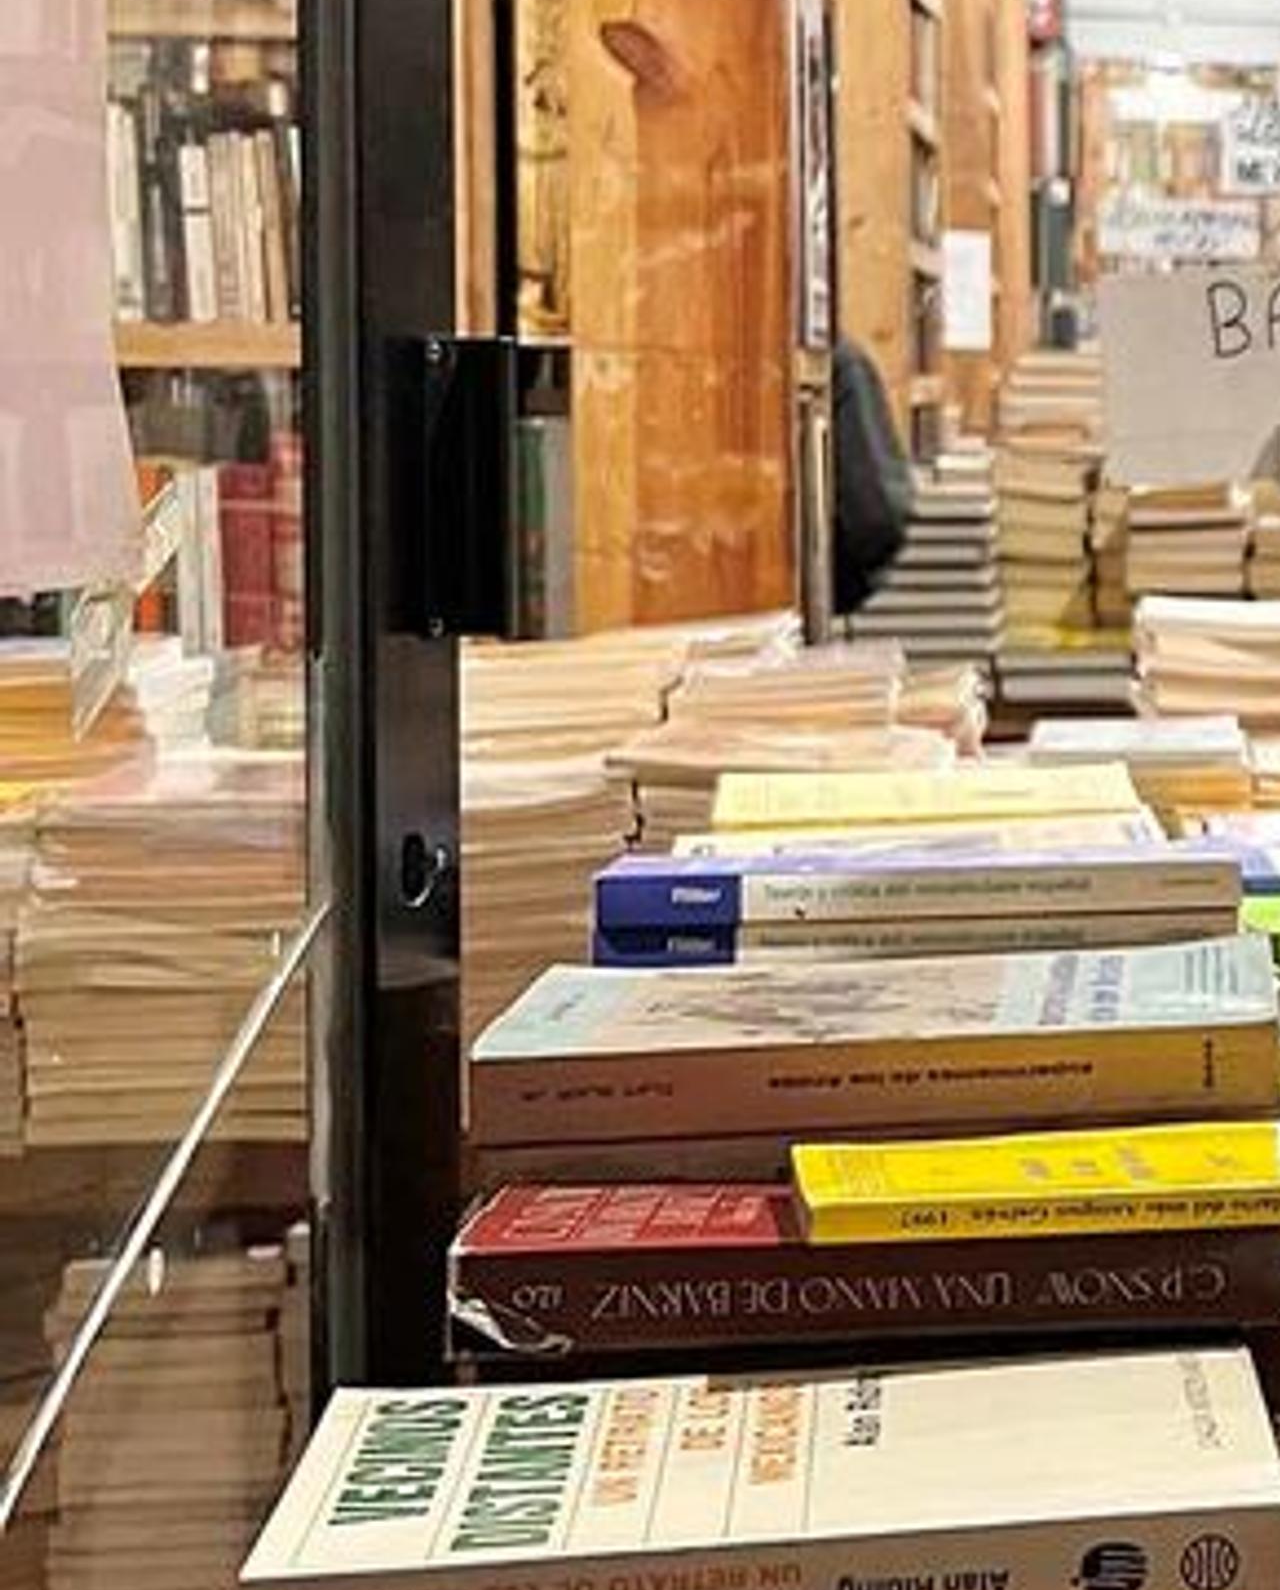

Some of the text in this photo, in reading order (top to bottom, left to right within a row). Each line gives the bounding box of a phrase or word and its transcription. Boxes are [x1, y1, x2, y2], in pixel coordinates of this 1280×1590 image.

[743, 1279, 791, 1314] DE
[803, 1275, 928, 1312] MANO
[932, 1273, 1011, 1308] UNA
[327, 1396, 469, 1526] VECINOS
[451, 1391, 589, 1553] DISTANTES
[759, 1563, 803, 1589] UN
